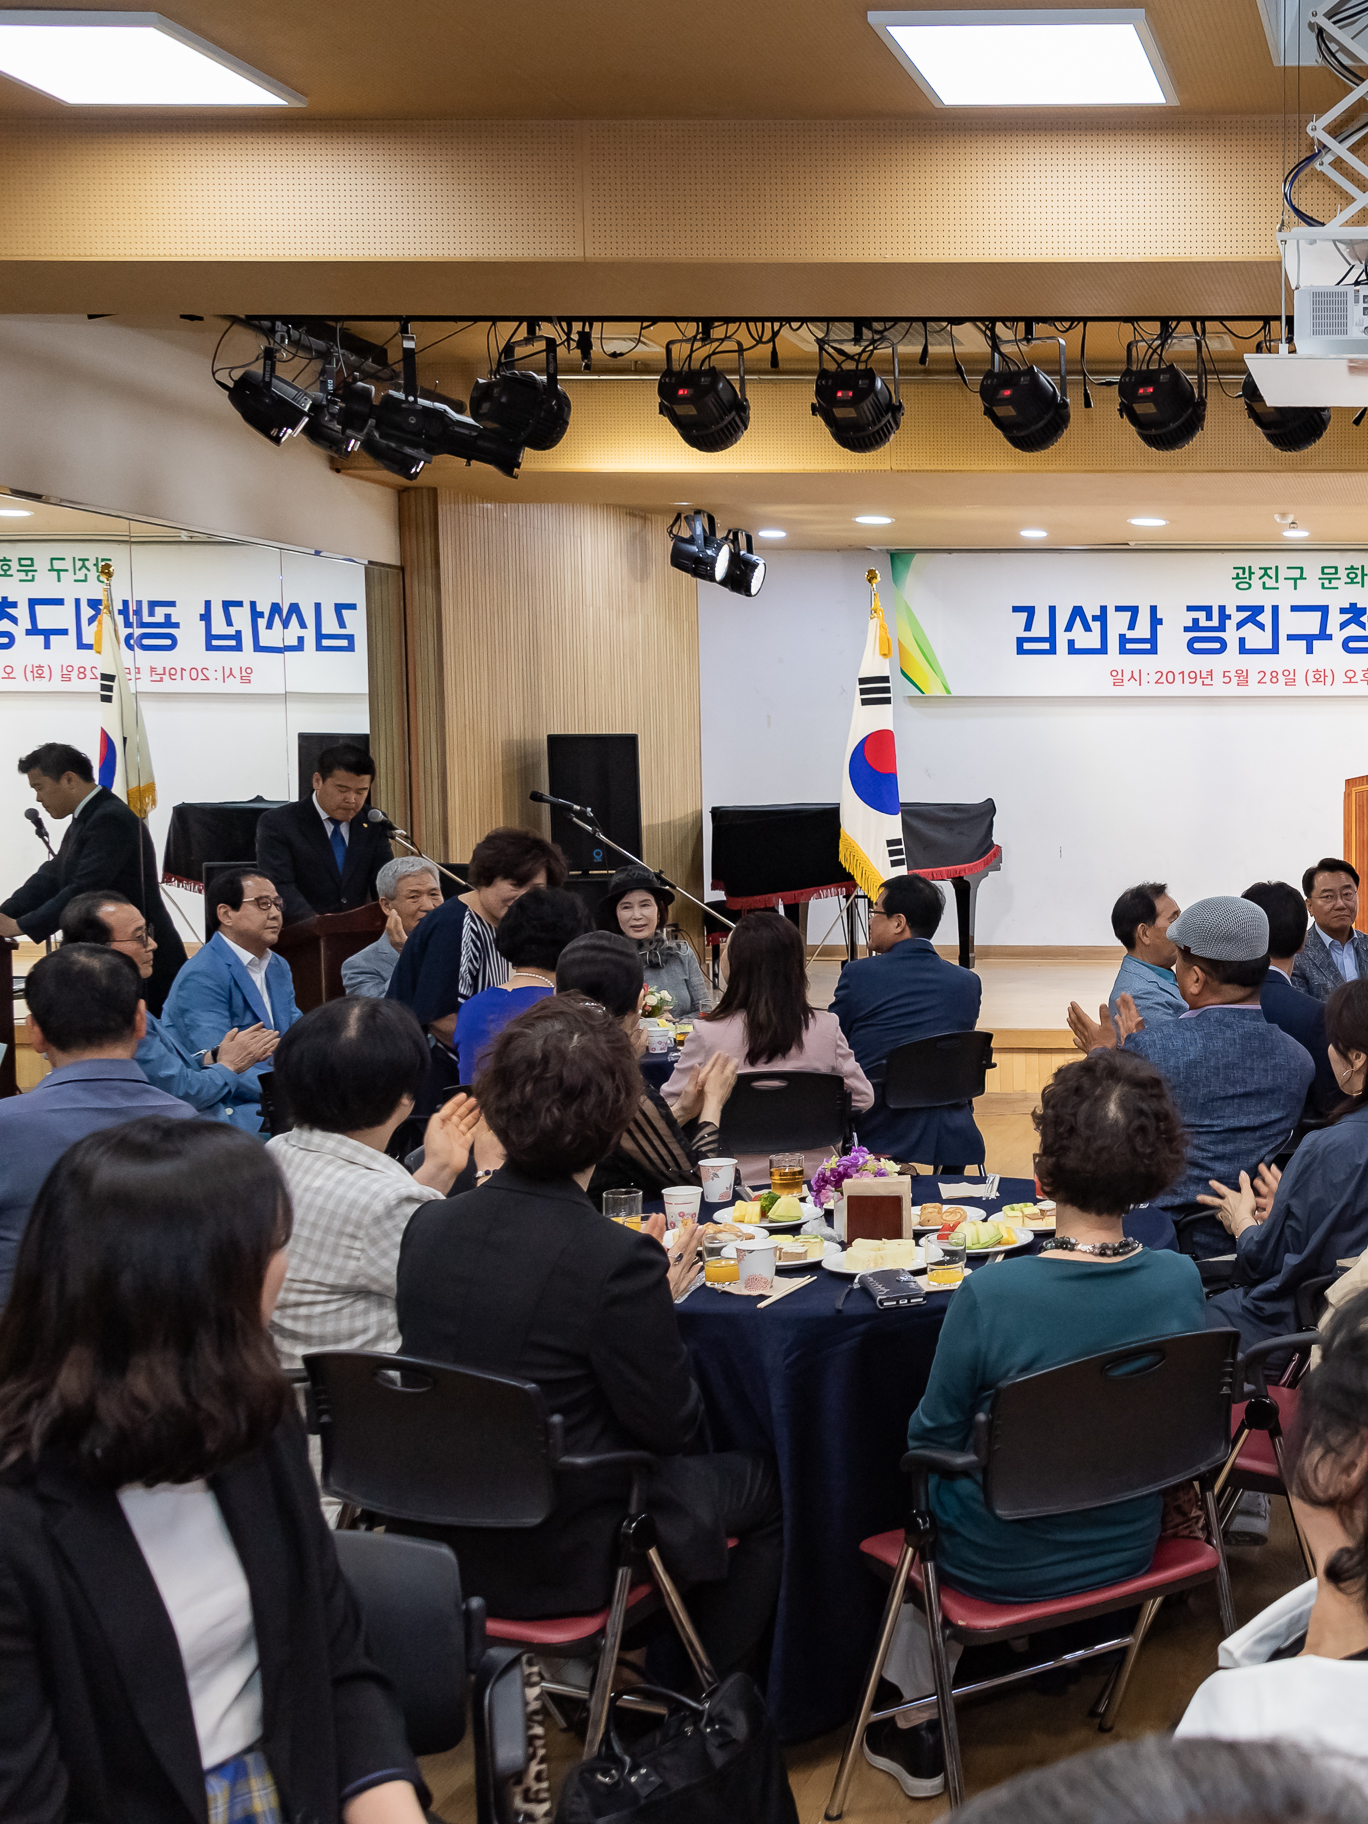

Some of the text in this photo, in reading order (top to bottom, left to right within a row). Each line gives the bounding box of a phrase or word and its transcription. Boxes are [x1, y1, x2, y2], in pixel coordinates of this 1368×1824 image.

[1232, 565, 1307, 591] 광진구
[1011, 604, 1164, 656] 김선갑
[1222, 668, 1249, 687] 5월
[1257, 668, 1297, 687] 28일
[1304, 668, 1335, 687] (화)
